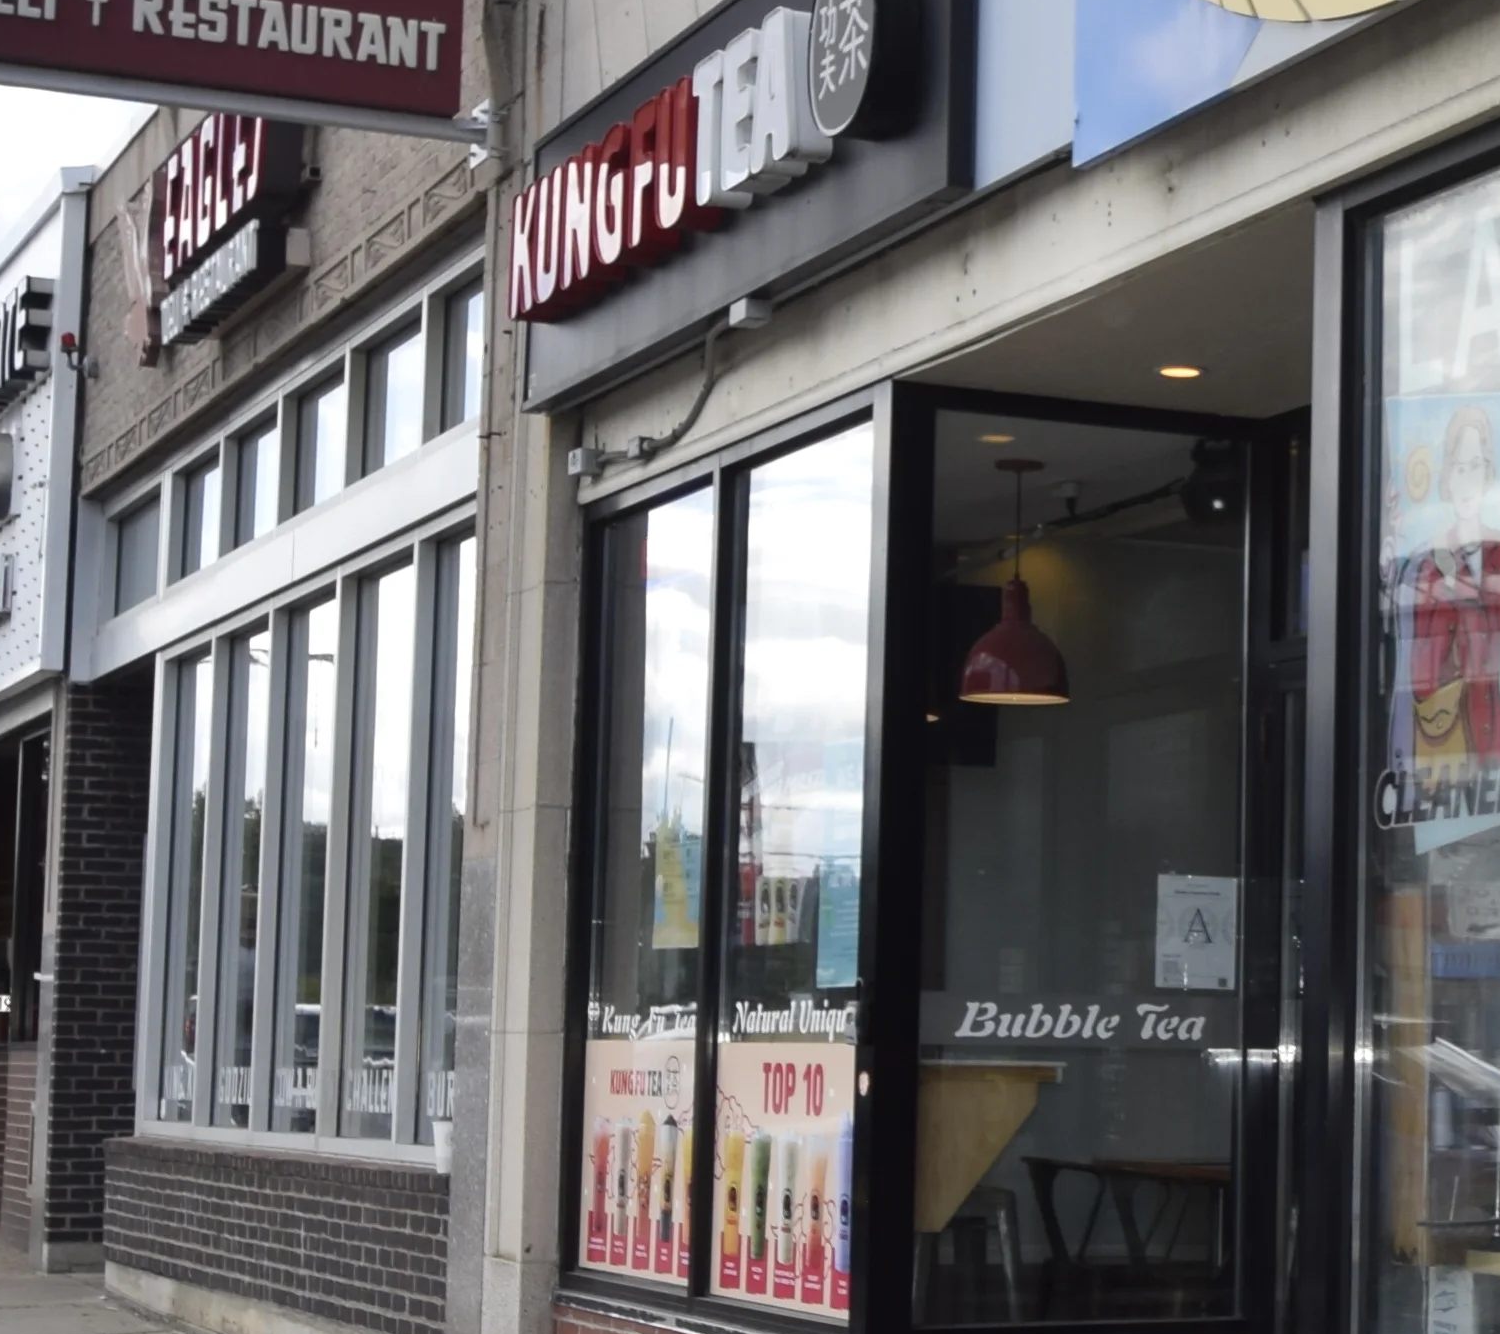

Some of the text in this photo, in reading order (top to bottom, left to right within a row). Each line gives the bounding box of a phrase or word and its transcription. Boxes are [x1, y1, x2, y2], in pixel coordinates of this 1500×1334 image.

[692, 6, 818, 208] TEA
[1183, 907, 1217, 945] A
[602, 1005, 640, 1042] Kung
[733, 999, 797, 1036] Natural
[954, 1001, 1206, 1041] Bubble Tea
[763, 1061, 825, 1118] TOP 10
